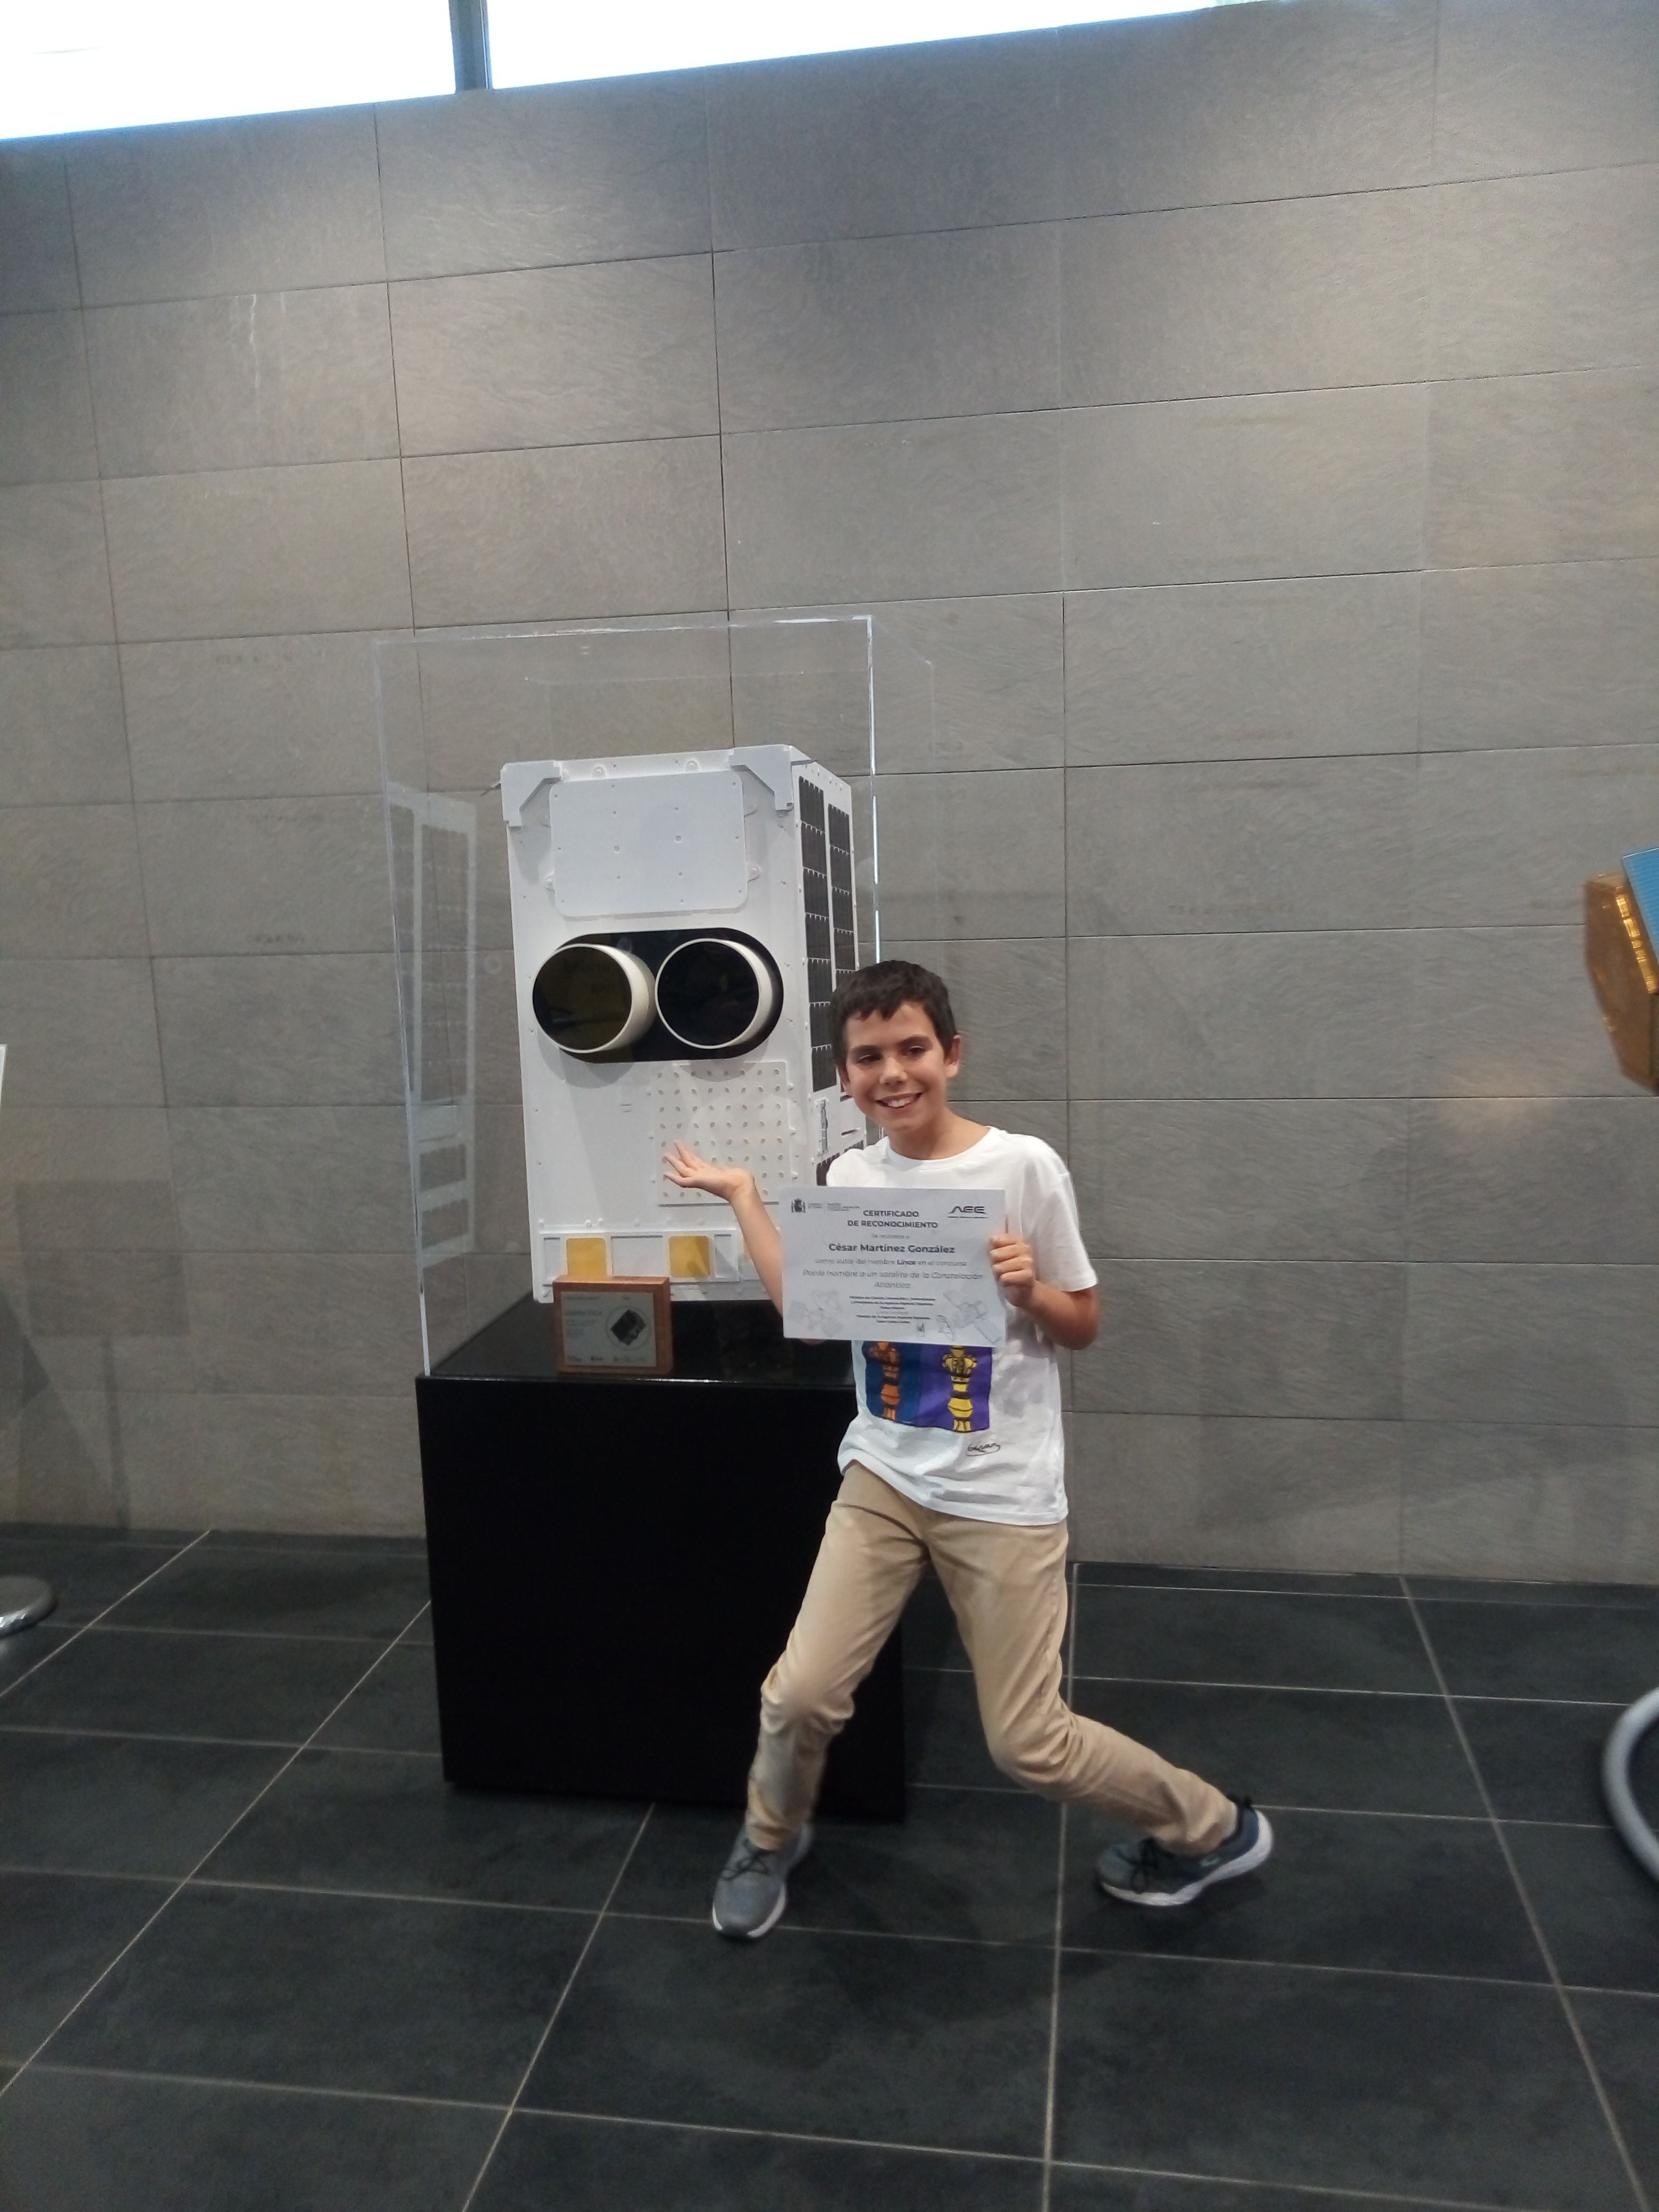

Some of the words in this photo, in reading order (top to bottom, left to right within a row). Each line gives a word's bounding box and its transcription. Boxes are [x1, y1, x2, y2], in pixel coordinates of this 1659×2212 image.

[828, 1242, 858, 1252] César
[860, 1243, 906, 1253] Martínez
[908, 1245, 956, 1254] González
